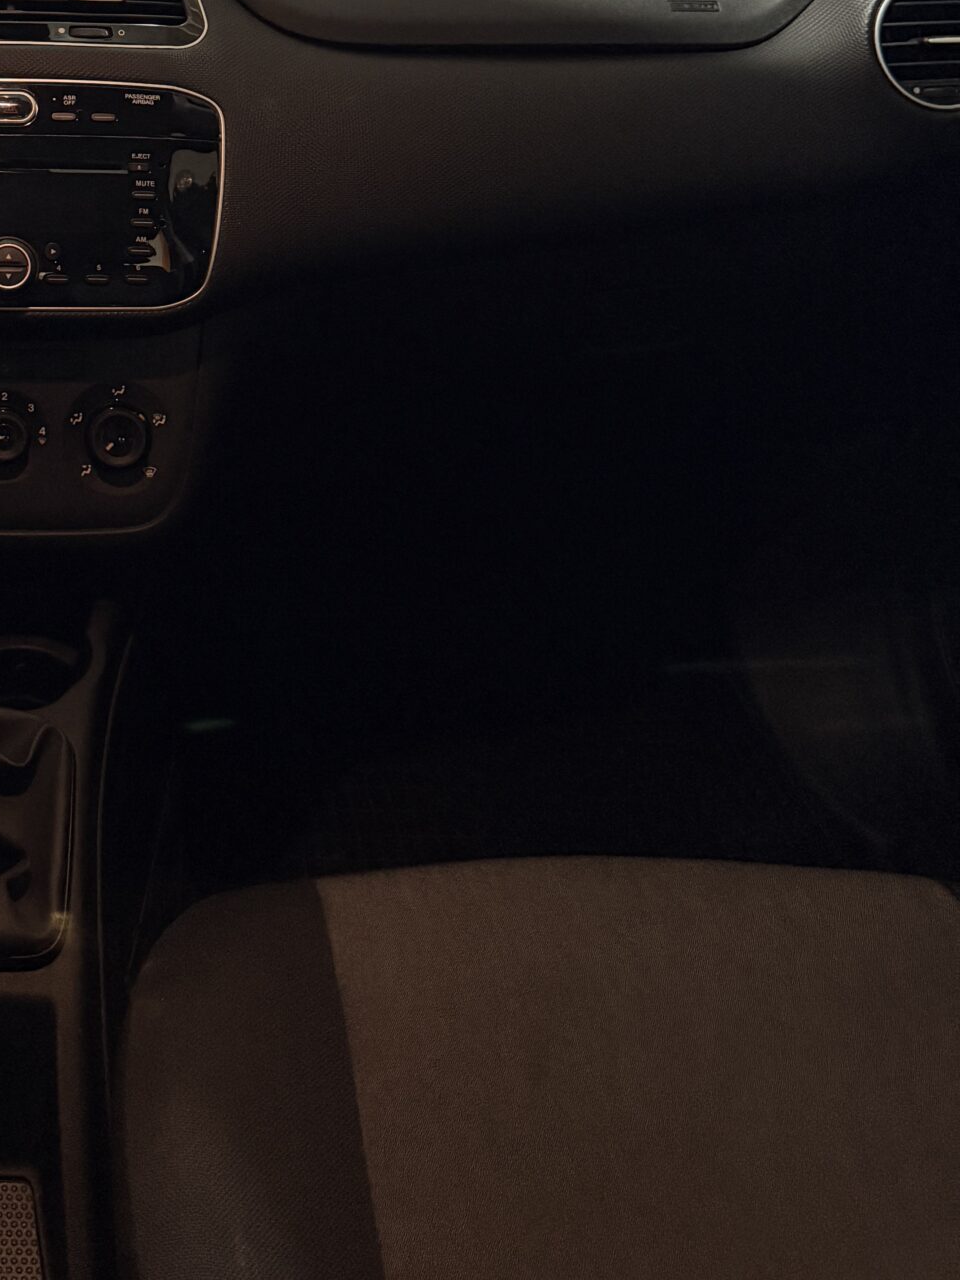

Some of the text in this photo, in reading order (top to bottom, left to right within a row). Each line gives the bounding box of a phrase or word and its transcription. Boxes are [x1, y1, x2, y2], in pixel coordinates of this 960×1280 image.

[125, 93, 161, 101] PASSENGER
[138, 207, 149, 215] FM
[0, 392, 9, 402] 2
[27, 402, 35, 413] 3
[38, 425, 47, 436] 4
